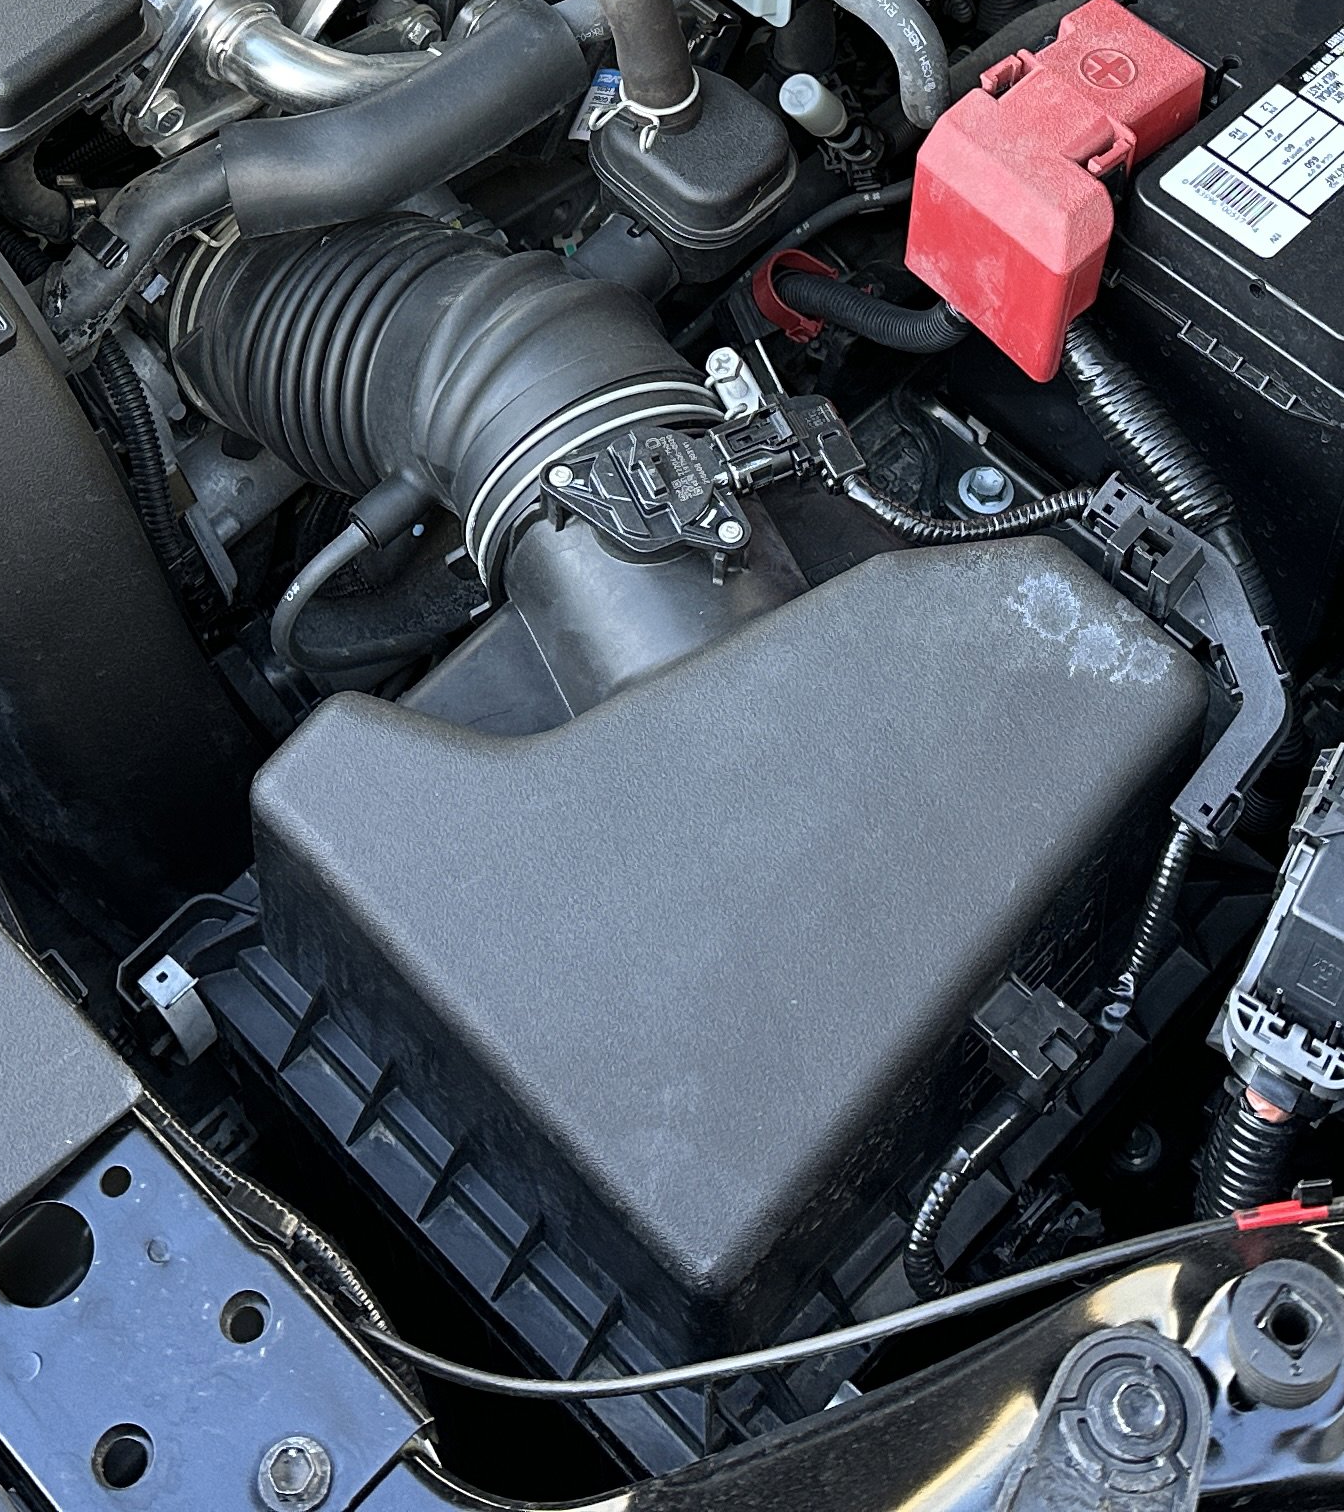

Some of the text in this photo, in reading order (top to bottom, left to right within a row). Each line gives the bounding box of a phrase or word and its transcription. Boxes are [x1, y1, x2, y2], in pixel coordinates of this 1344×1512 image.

[1259, 101, 1273, 112] L2
[1228, 127, 1242, 139] H5
[1264, 129, 1275, 139] 47
[1304, 156, 1320, 169] 650
